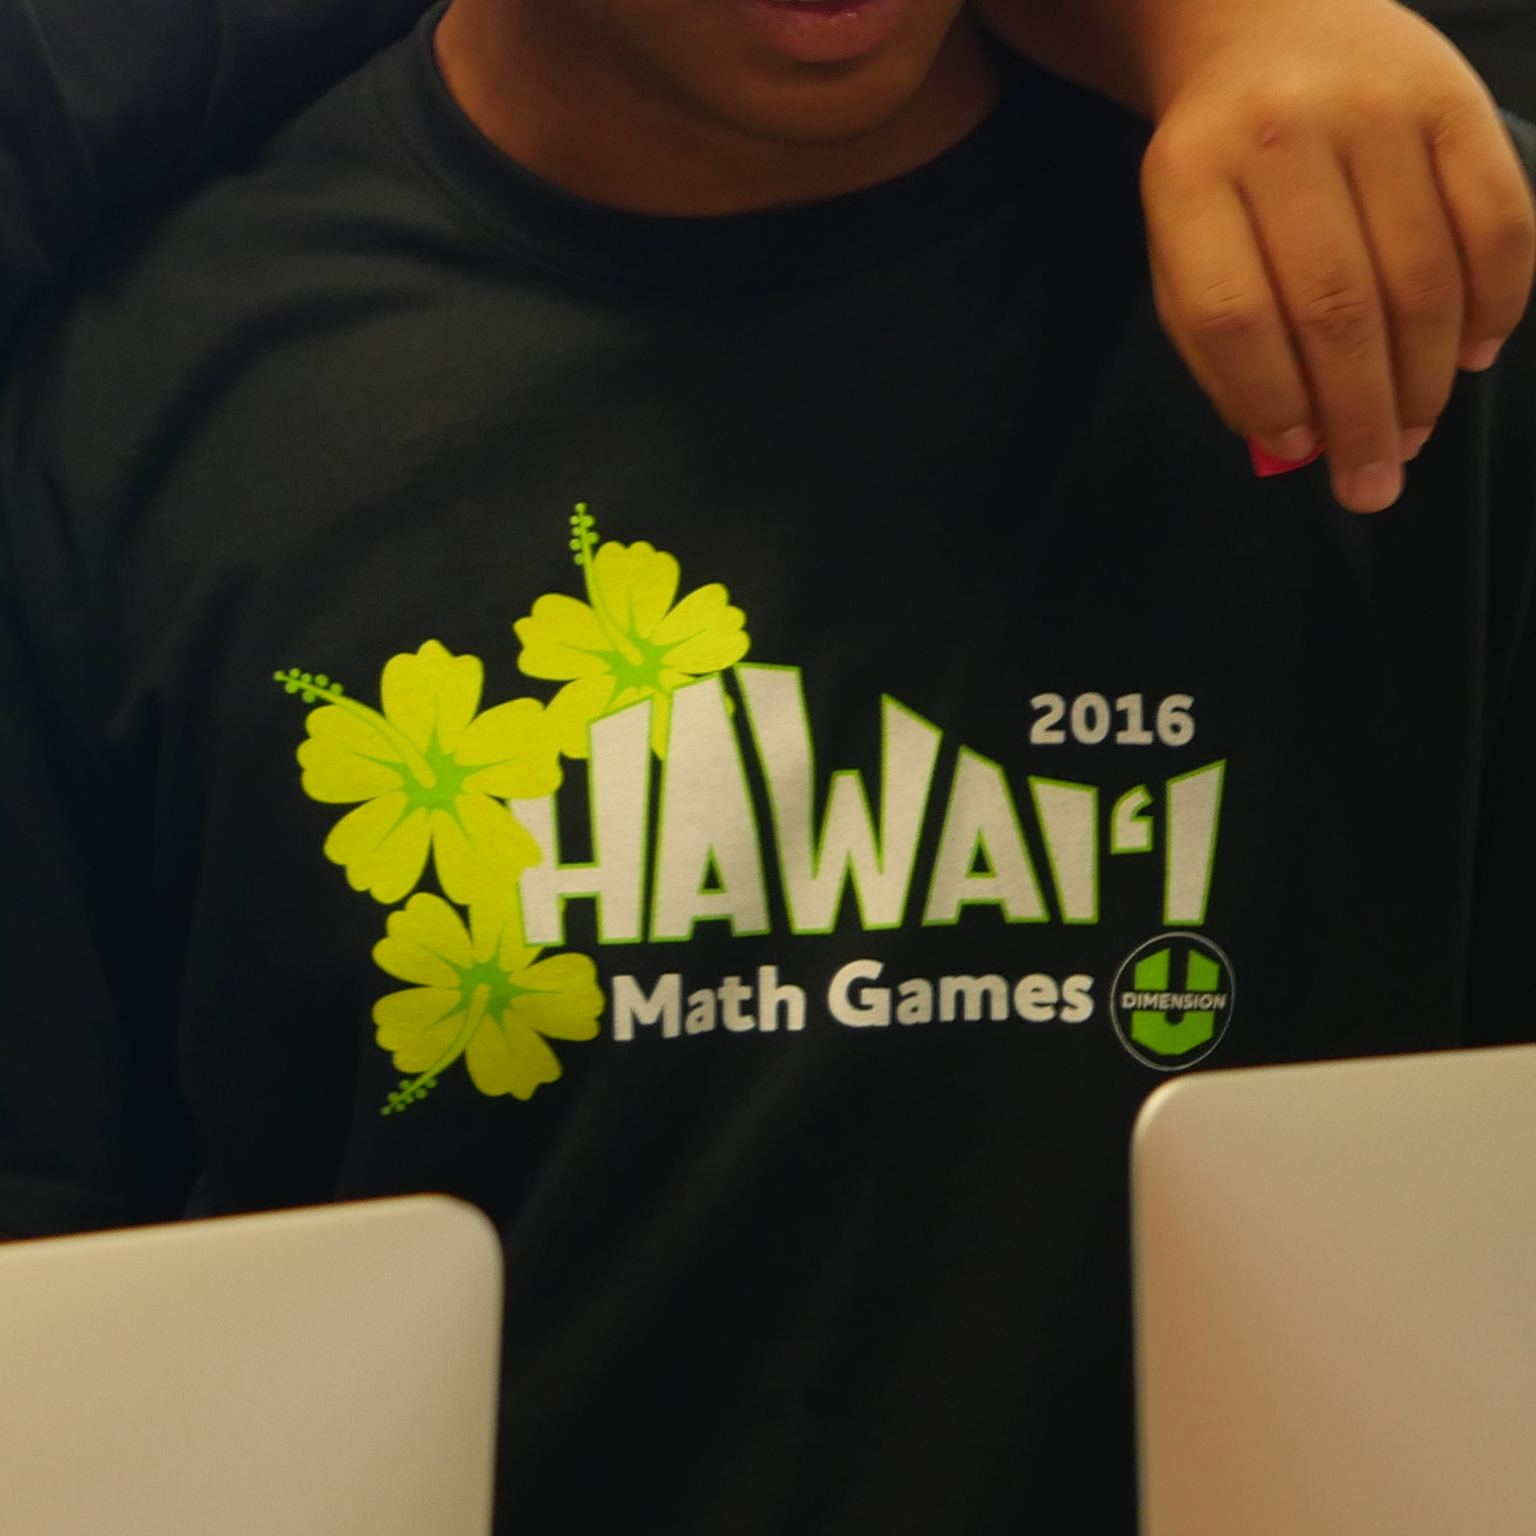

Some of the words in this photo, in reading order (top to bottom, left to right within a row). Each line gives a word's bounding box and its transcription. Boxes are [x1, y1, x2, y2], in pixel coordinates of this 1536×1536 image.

[1030, 692, 1195, 746] 2016
[612, 965, 806, 1041] Math
[828, 959, 1095, 1028] Games
[1122, 992, 1227, 1011] DIMENSION
